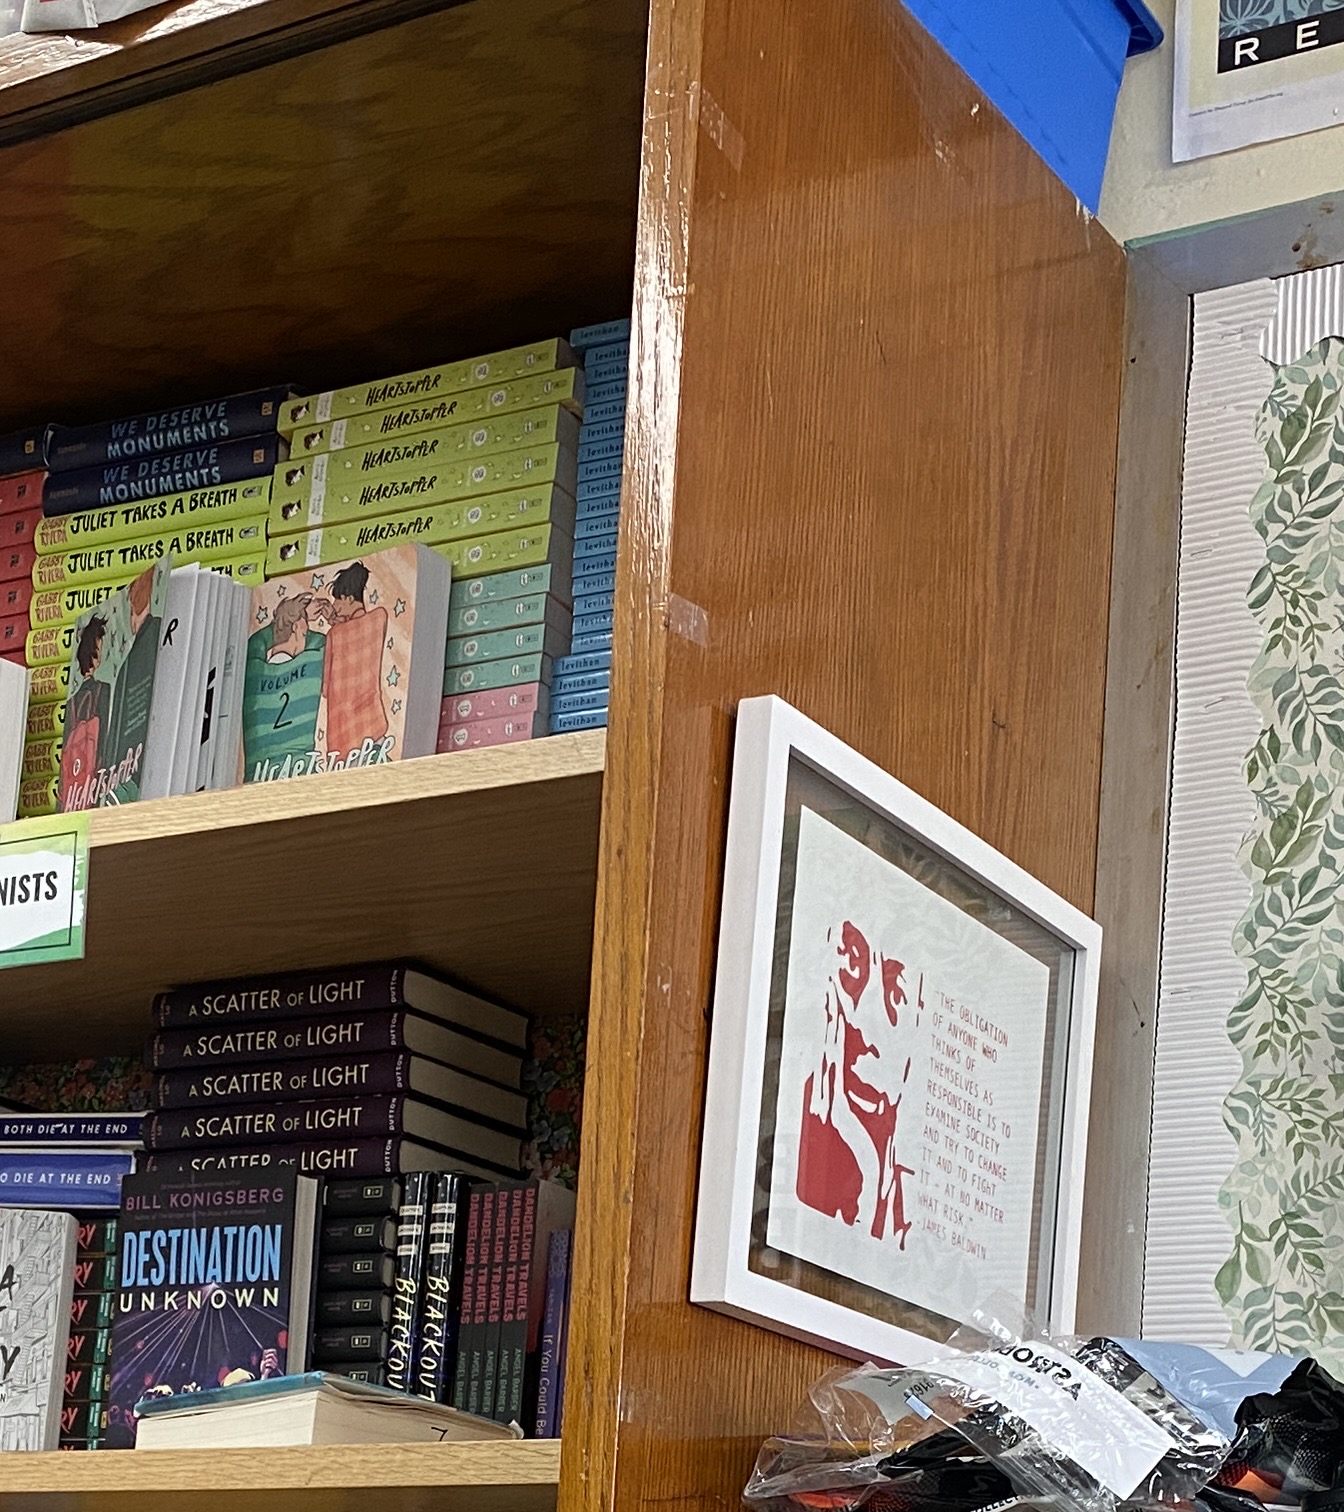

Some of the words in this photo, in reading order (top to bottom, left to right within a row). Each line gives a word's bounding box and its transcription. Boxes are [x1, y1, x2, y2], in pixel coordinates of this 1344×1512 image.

[70, 511, 117, 535] JULIET
[122, 501, 167, 527] TAKES
[170, 497, 184, 515] A
[189, 486, 237, 512] BREATH
[188, 1004, 198, 1016] A
[202, 990, 281, 1014] SCATTER
[287, 992, 305, 1006] OF
[308, 980, 365, 1003] LIGHT
[932, 1013, 943, 1027] OF
[948, 1022, 977, 1047] ANYONE
[931, 1033, 962, 1064] THINKS
[965, 1057, 976, 1072] OF
[126, 1194, 161, 1212] BILL
[168, 1187, 284, 1209] KONIGSBERG
[121, 1224, 282, 1287] DESTINATION
[952, 1229, 986, 1260] BALDWIN
[119, 1288, 280, 1314] UNKNOWN
